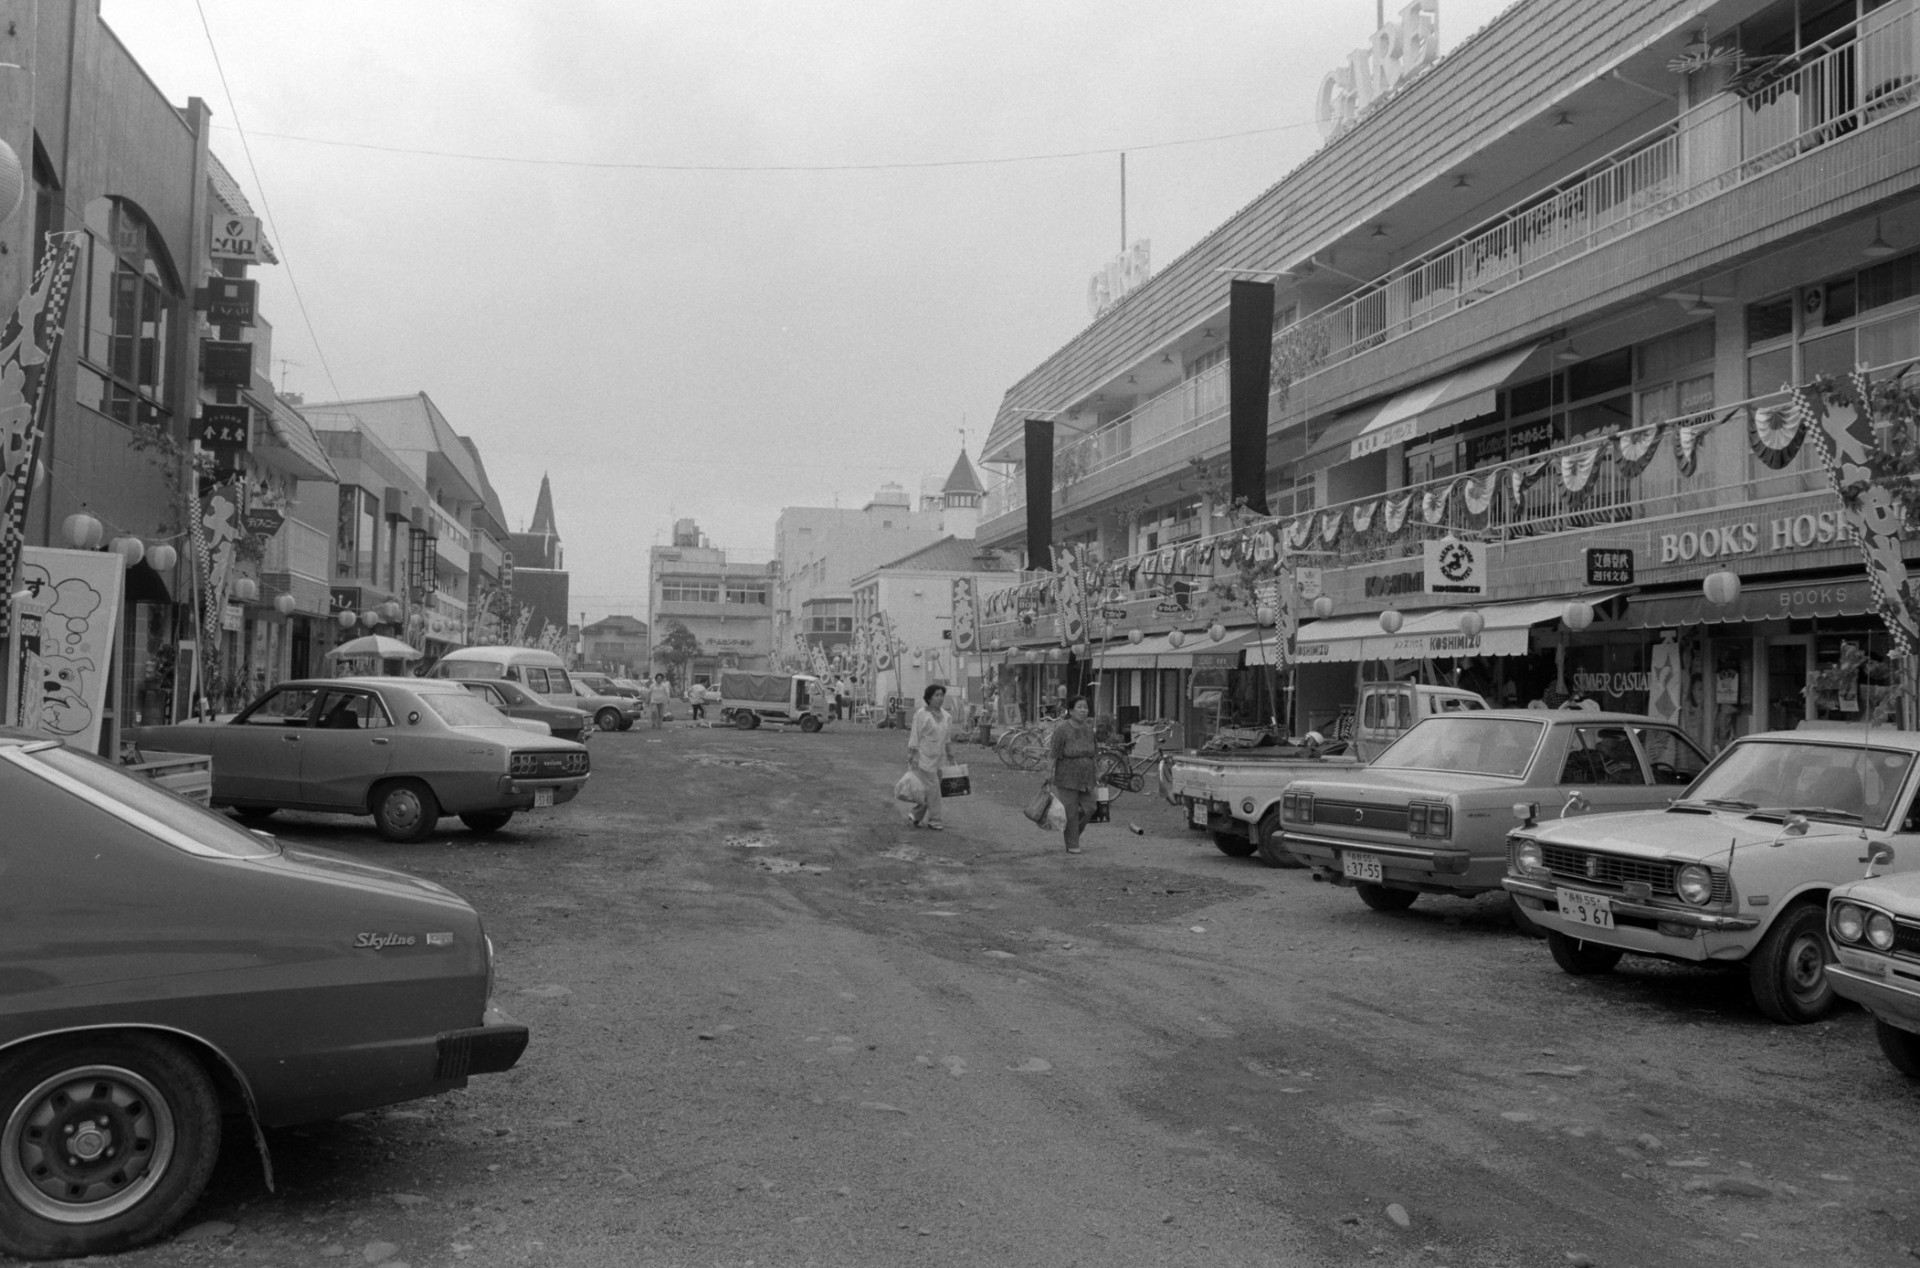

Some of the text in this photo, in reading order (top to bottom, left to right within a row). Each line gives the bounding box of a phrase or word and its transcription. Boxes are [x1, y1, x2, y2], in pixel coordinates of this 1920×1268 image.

[1660, 522, 1758, 563] BOOKS
[1780, 587, 1848, 606] BOOKS
[1297, 644, 1329, 656] OSHIMIZU
[1430, 635, 1481, 651] KOSHIMIZU
[354, 932, 417, 949] Skyline
